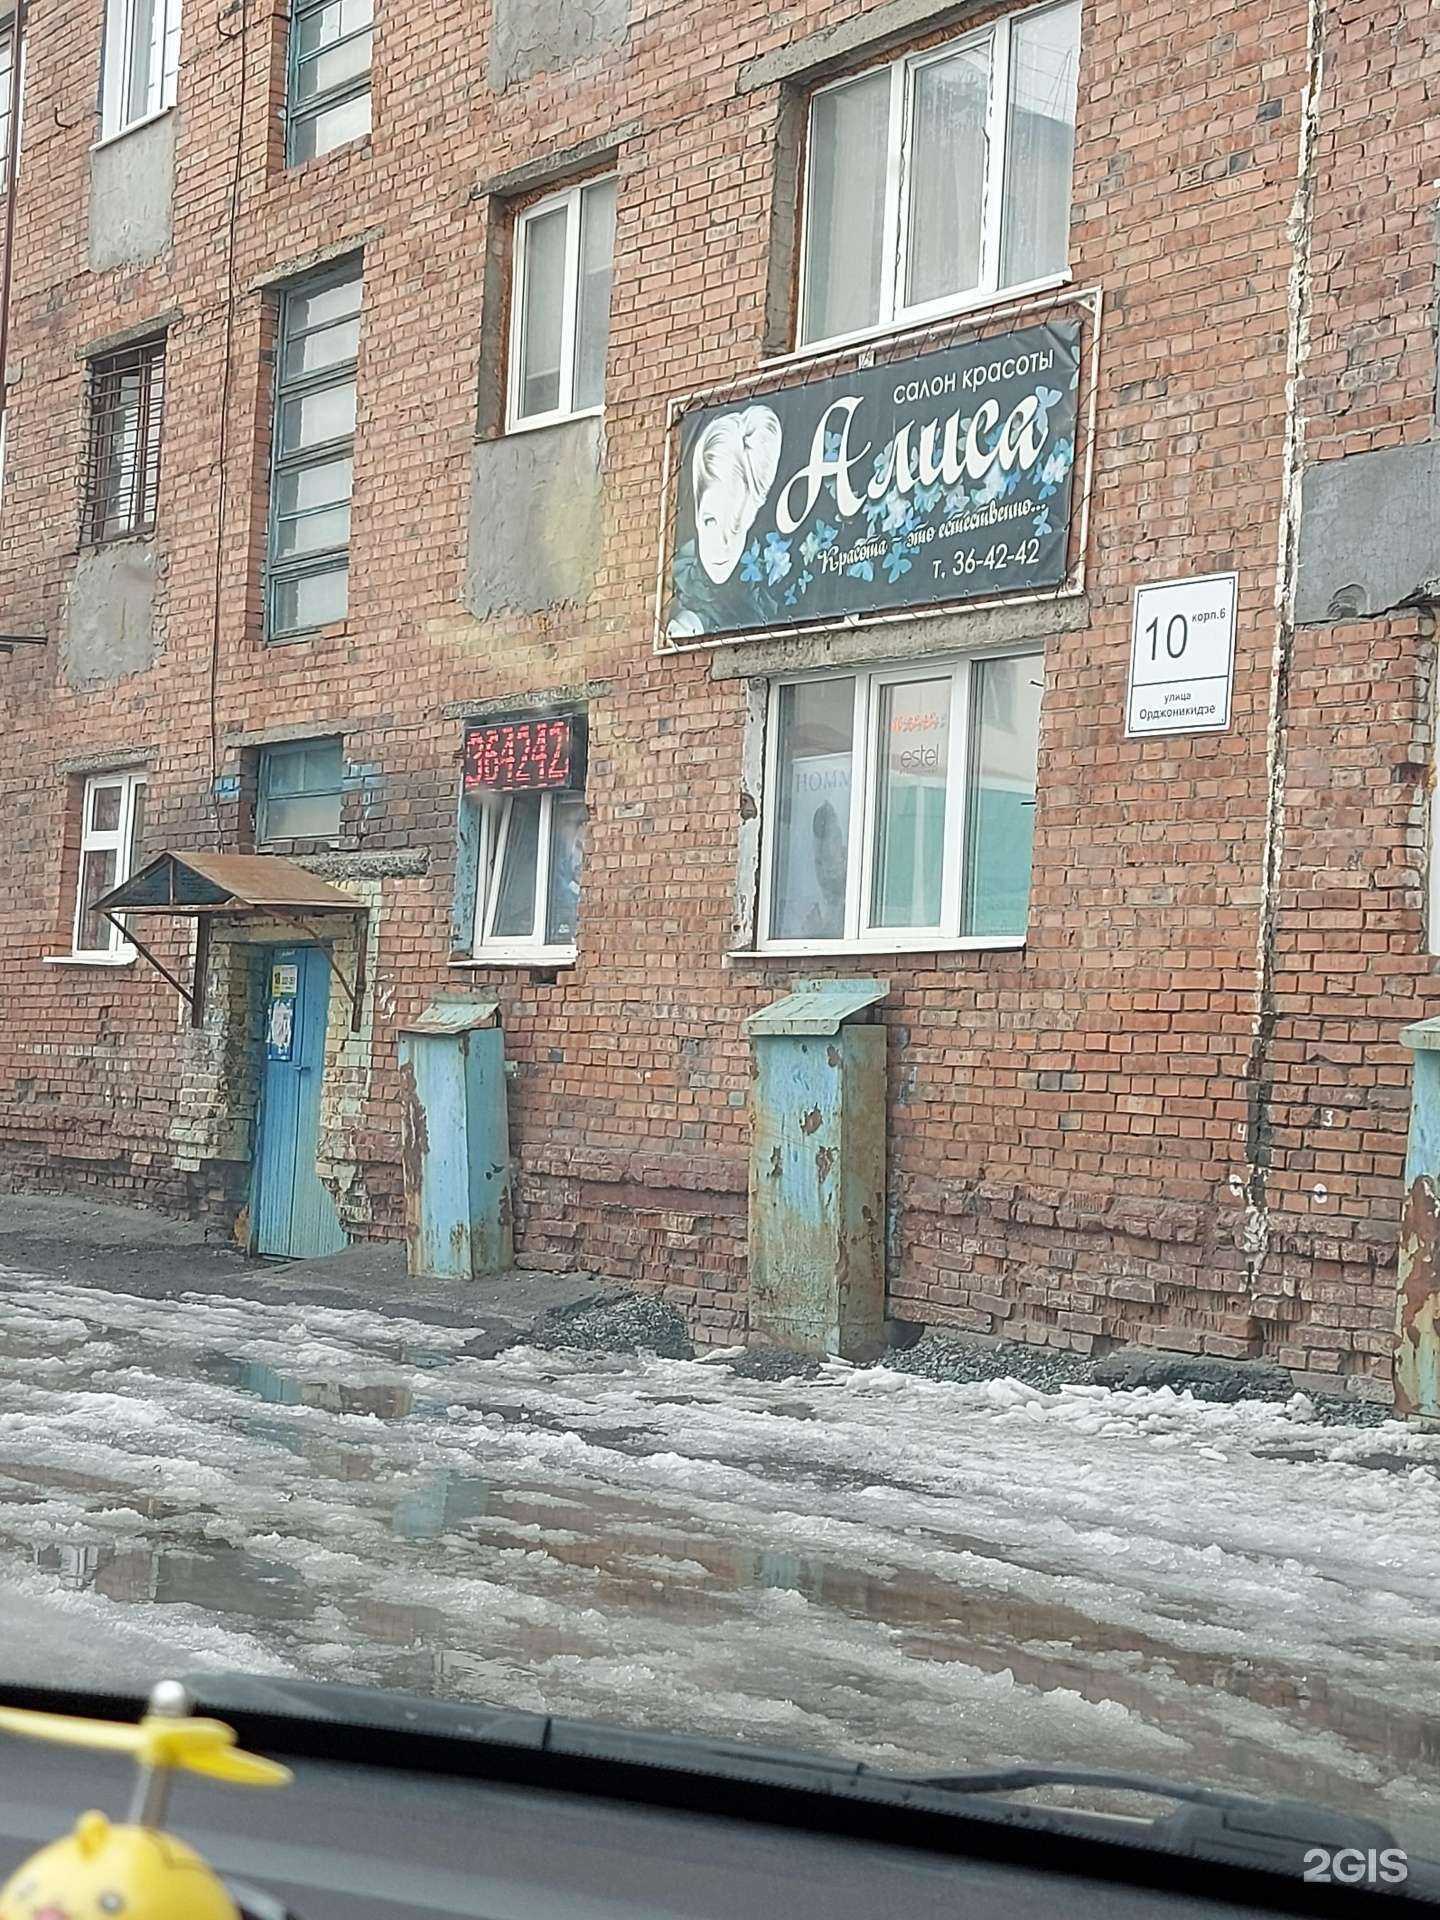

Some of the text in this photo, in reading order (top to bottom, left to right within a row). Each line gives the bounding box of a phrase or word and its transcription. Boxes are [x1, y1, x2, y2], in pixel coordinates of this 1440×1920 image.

[893, 348, 1054, 404] салон красоты
[776, 394, 1049, 534] Алиса
[817, 535, 888, 576] Красота
[906, 521, 936, 548] это
[932, 539, 1040, 579] т. 36-42-42
[1145, 607, 1226, 661] 10 корп.6
[1139, 704, 1216, 722] Орджоникидзе
[1163, 692, 1192, 705] улица
[465, 721, 569, 785] 364242
[900, 744, 939, 768] estel
